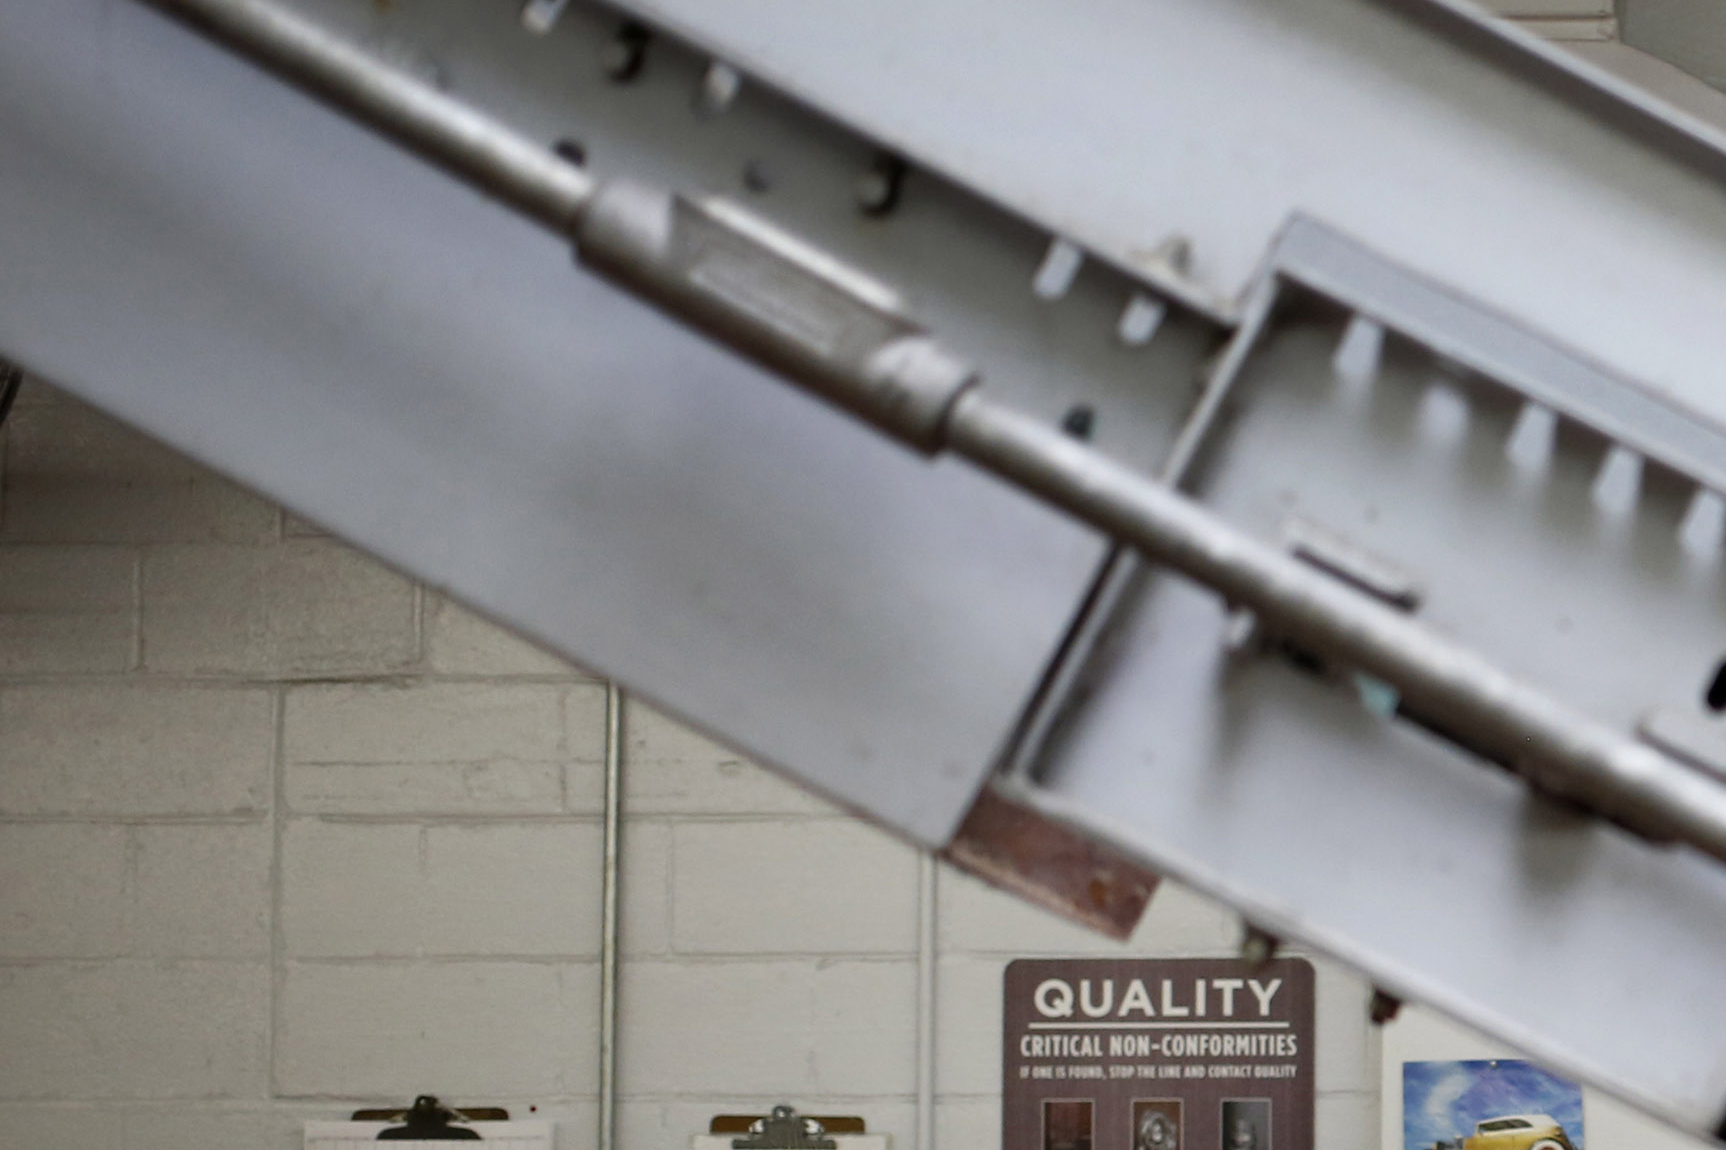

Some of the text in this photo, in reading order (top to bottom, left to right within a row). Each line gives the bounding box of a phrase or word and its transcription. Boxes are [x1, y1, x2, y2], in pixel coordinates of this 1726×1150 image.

[1034, 978, 1282, 1017] QUALITY
[1020, 1034, 1298, 1057] CRITICAL NON-CONFORMITIES
[1019, 1065, 1298, 1079] IF ONE IS FOUND, STOP THE LINE AND CONTACT QUALITY
